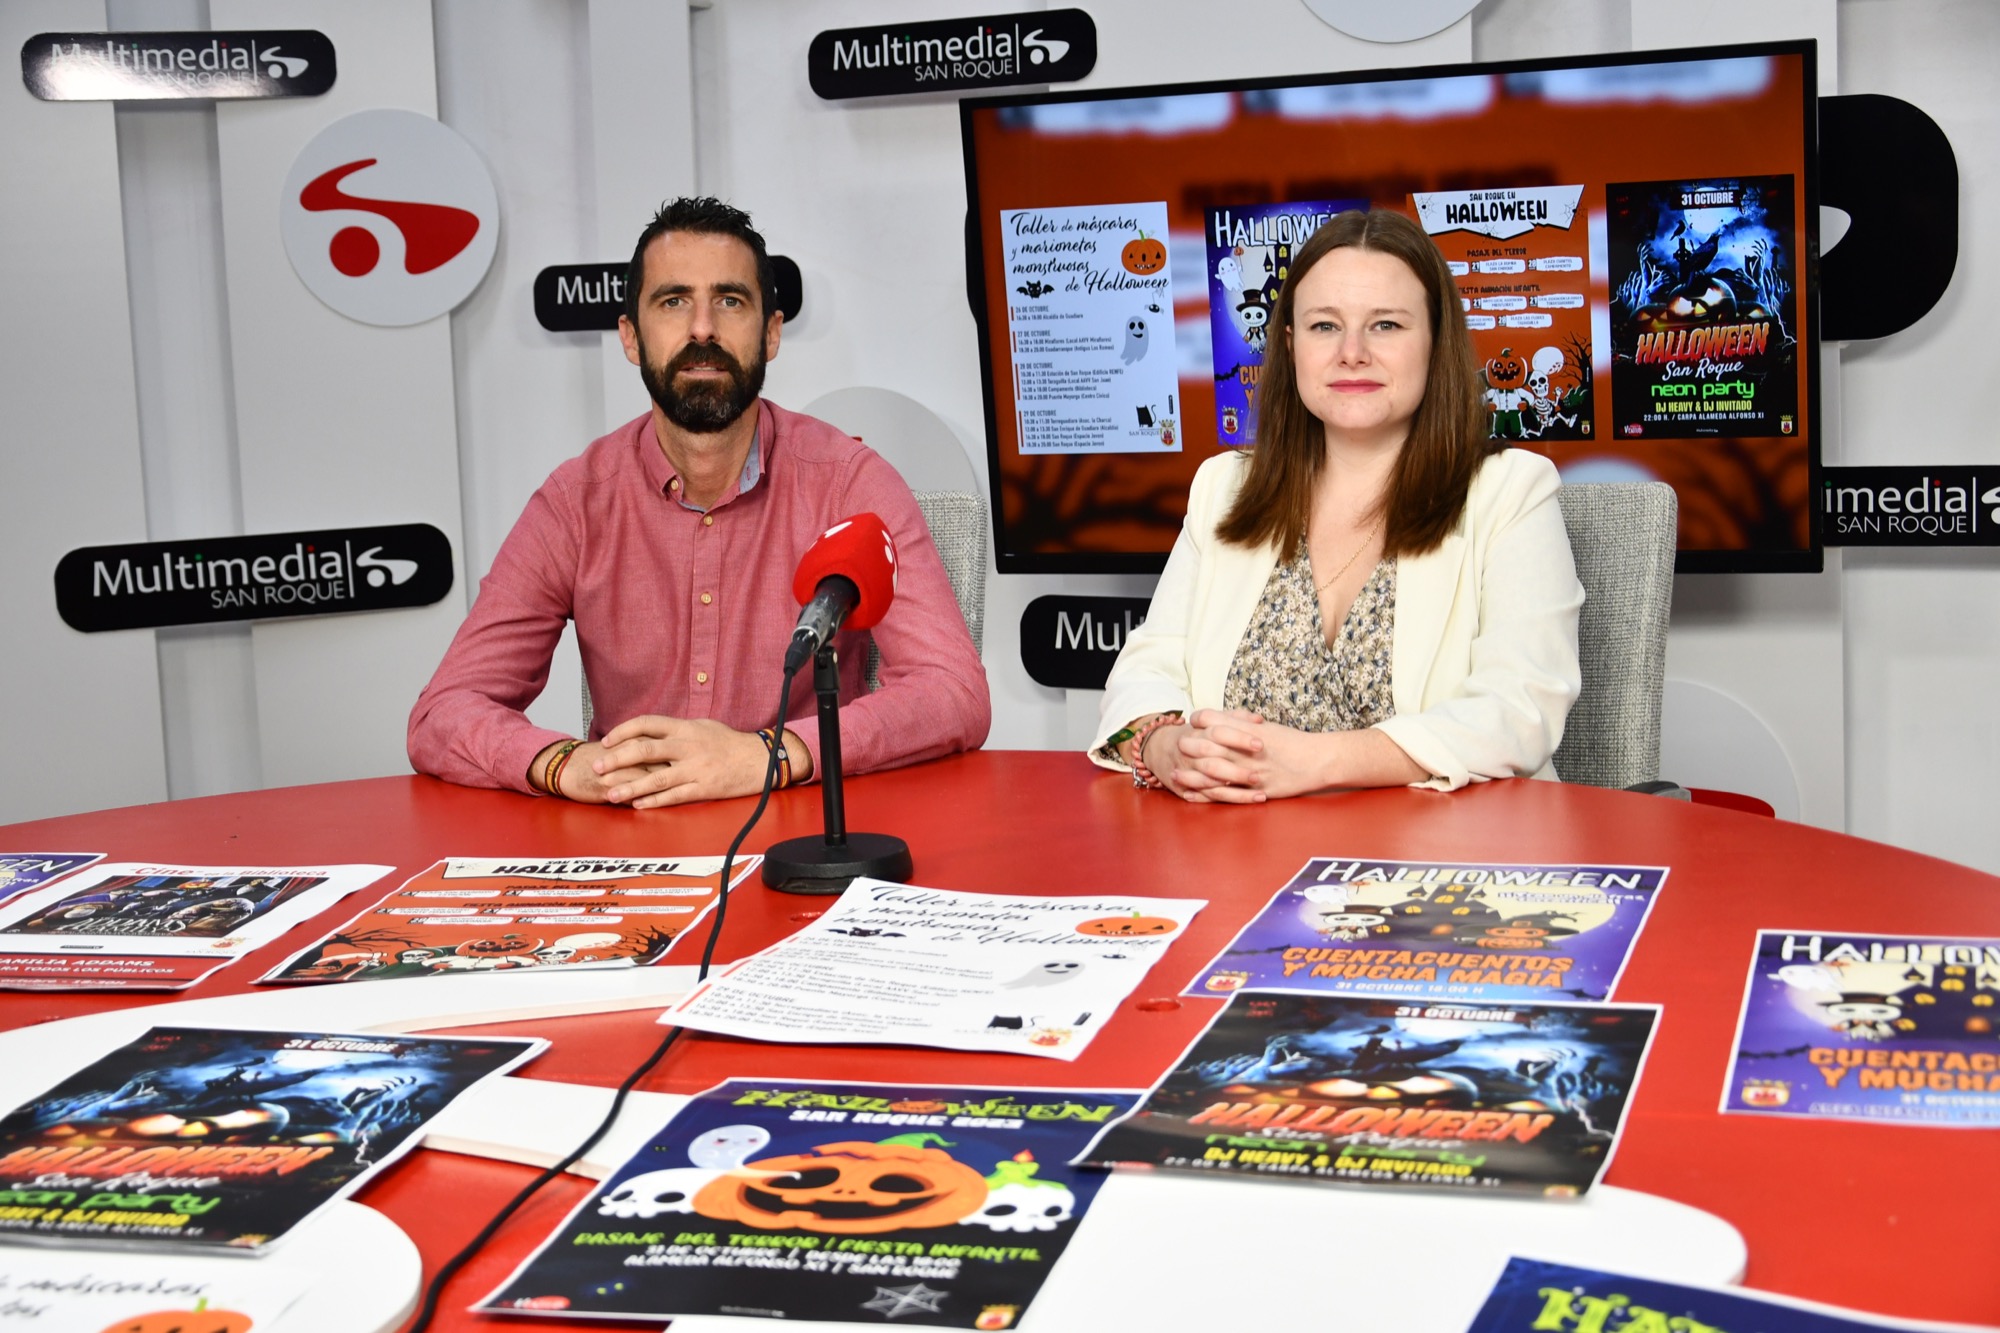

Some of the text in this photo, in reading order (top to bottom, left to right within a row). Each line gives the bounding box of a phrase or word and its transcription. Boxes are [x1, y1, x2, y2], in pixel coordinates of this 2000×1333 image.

[833, 26, 1012, 71] Multimedia
[147, 72, 181, 87] AN
[914, 58, 1013, 82] SAN ROQUE
[1470, 191, 1516, 201] SAN ROQUE EN
[1681, 191, 1734, 206] 31 OCTUBRE
[1446, 200, 1547, 224] HALLOWEEN
[1010, 212, 1137, 236] Taller de máscaras
[1021, 237, 1097, 254] marionetas
[1504, 248, 1527, 256] TERROR
[1013, 257, 1090, 275] monstruosas
[1065, 268, 1169, 295] de Halloween
[1635, 322, 1769, 365] HALLOWEEN
[1662, 357, 1744, 381] San Roque
[1651, 379, 1755, 399] neon party
[1656, 400, 1752, 412] DJ HEAVY & DJ INVITADO
[1728, 412, 1755, 420] ALFONSO
[1837, 515, 1967, 536] SAN ROQUE
[92, 542, 344, 597] Multimedia
[211, 579, 345, 609] SAN ROQUE
[492, 863, 680, 874] HALLOWEEN
[1317, 861, 1642, 891] HALLOWEEN
[72, 959, 155, 967] ADDAMS
[1282, 947, 1574, 972] CUENTACUENTOS
[1283, 962, 1563, 988] Y MUCHA MAGIA
[1355, 983, 1423, 992] OCTUBRE
[1394, 1006, 1517, 1022] 31 OCTUBRE
[284, 1039, 400, 1053] 31 OCTUBRE
[1819, 1067, 1848, 1089] Y
[789, 1109, 1025, 1130] SAN ROQUE 2023
[1186, 1102, 1555, 1144] HALLOWEEN
[1203, 1147, 1473, 1177] DJ HEAVY & DJ INVITADO
[573, 1232, 665, 1246] PASAJE
[673, 1232, 717, 1246] DEL
[728, 1233, 820, 1249] TERROR
[838, 1239, 925, 1256] FIESTA
[929, 1243, 1042, 1262] INFANTIL
